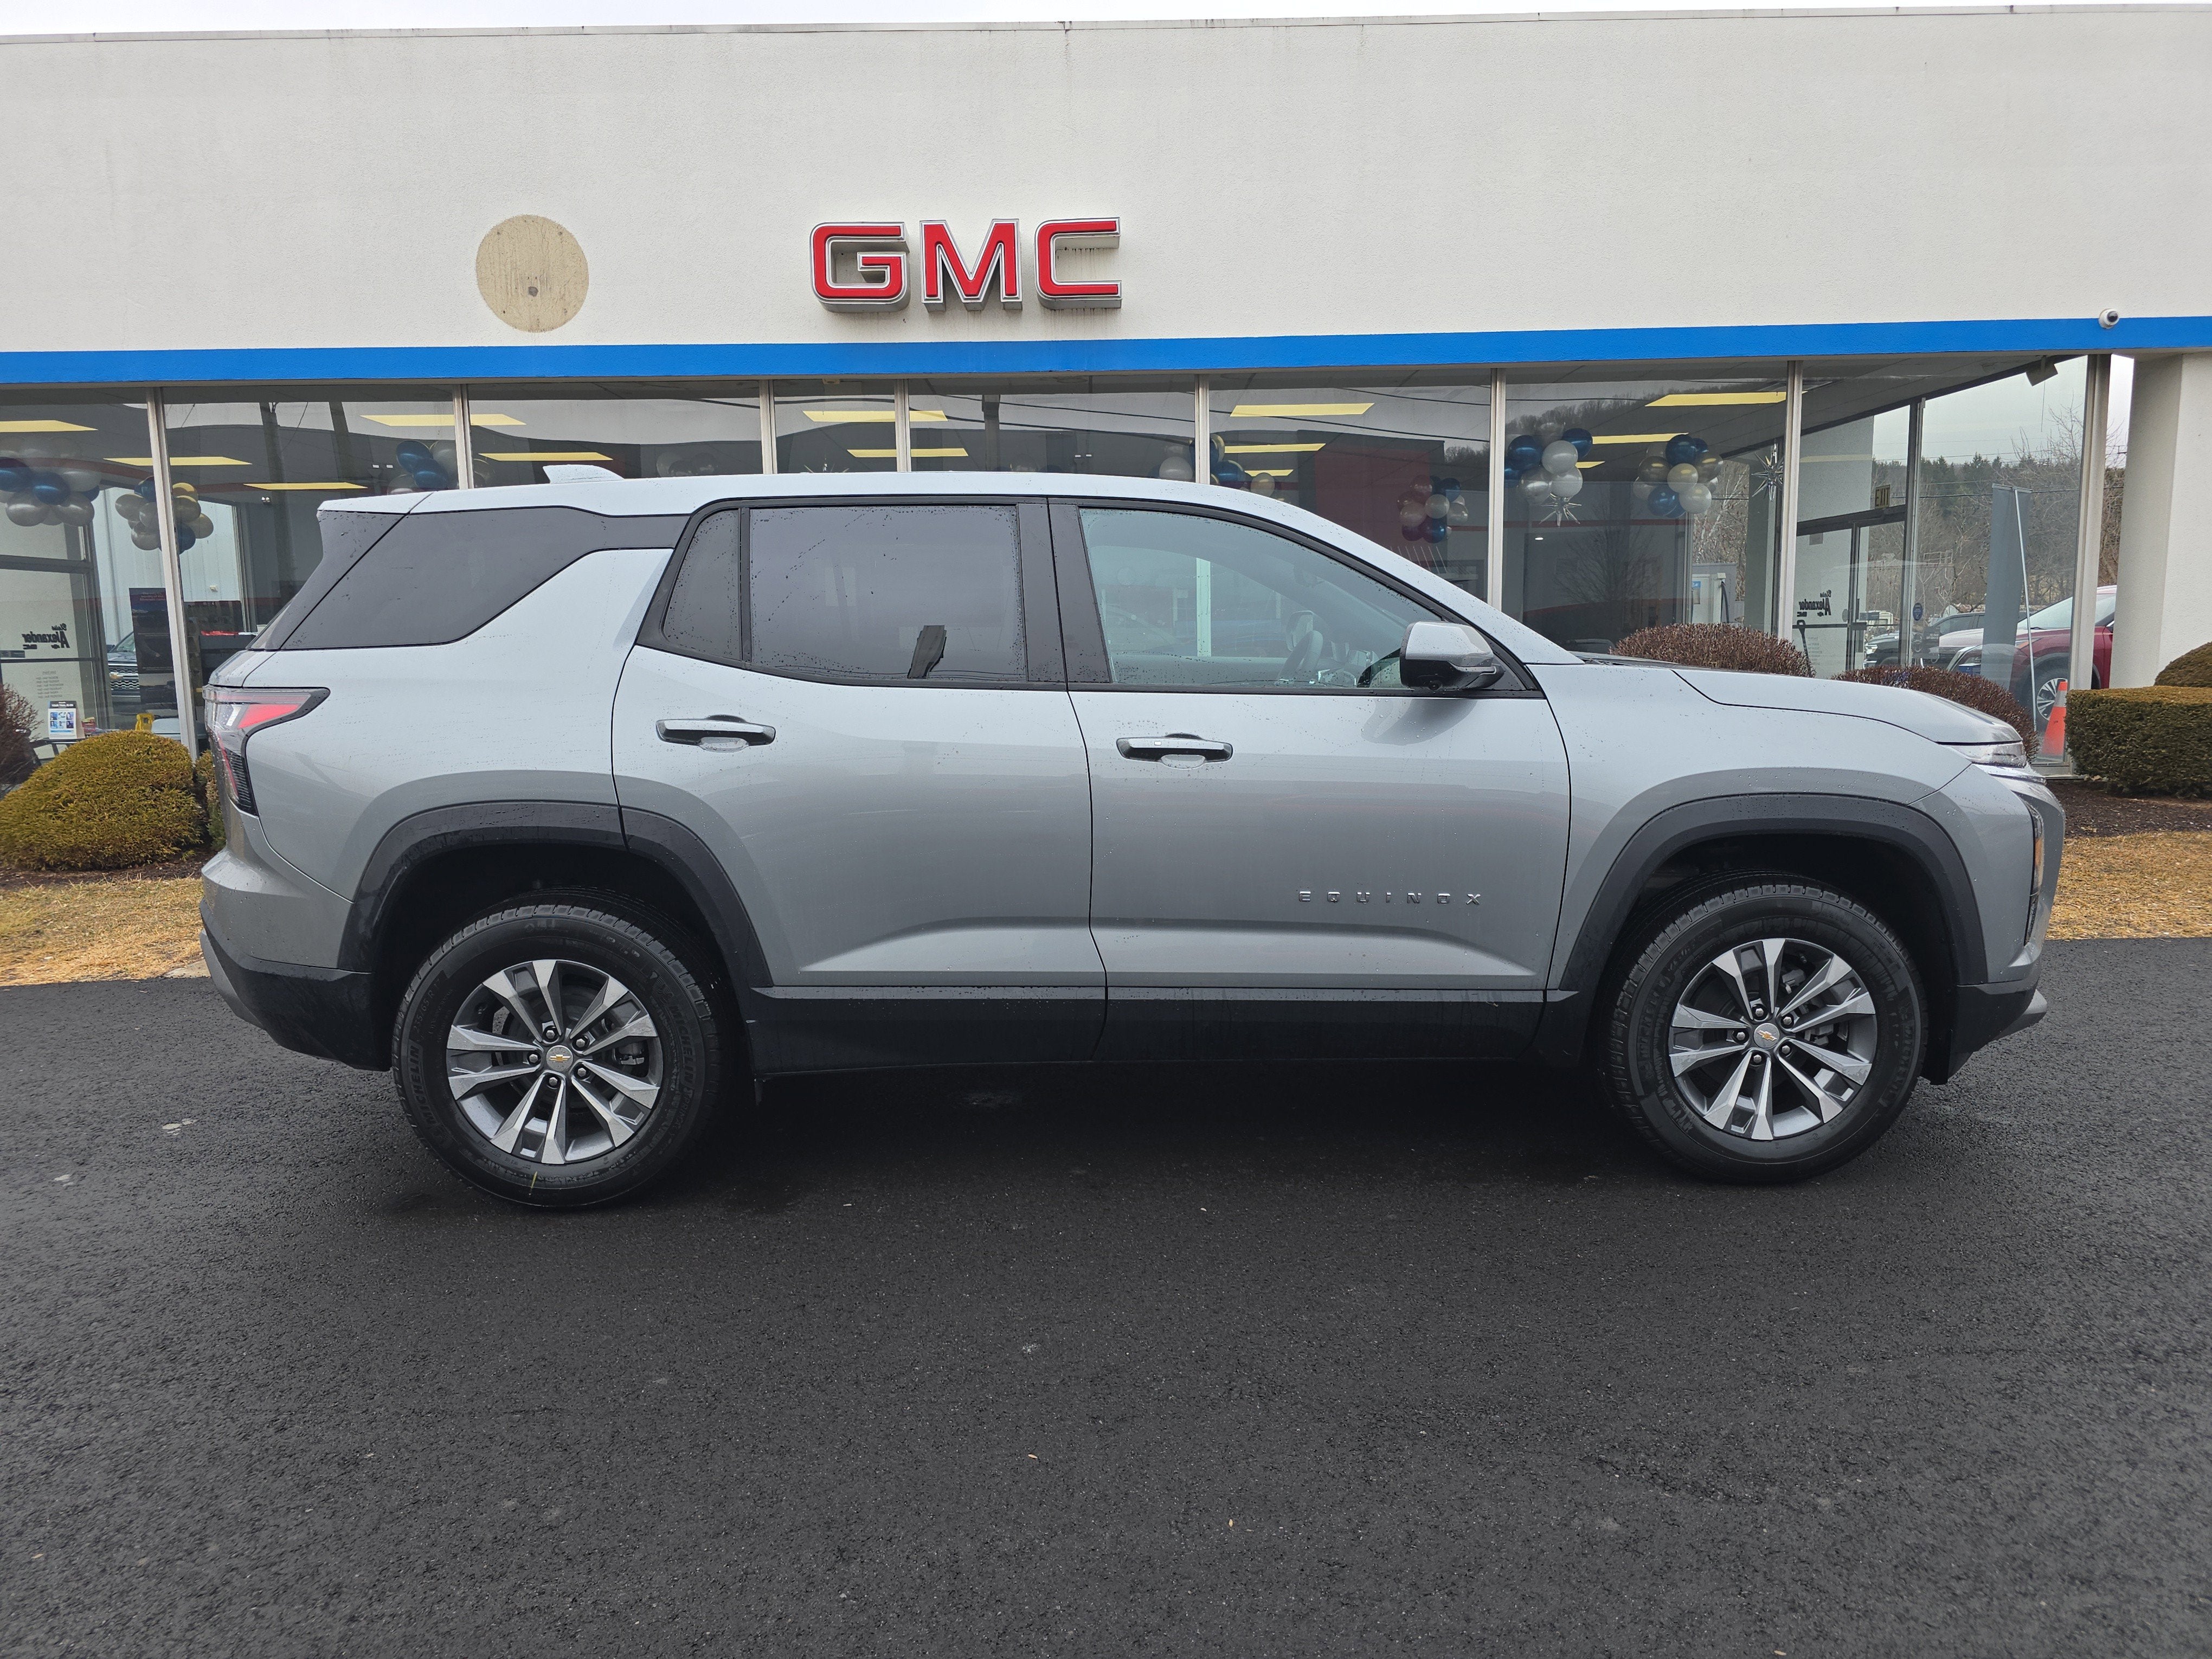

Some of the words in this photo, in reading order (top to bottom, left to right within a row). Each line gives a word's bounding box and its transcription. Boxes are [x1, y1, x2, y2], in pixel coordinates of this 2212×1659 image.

[811, 217, 1122, 313] GMC
[1875, 488, 1890, 507] EXIT
[1298, 891, 1481, 905] EQUINOX
[668, 1006, 694, 1083] MICHELIN
[410, 1046, 436, 1124] MICHELIN
